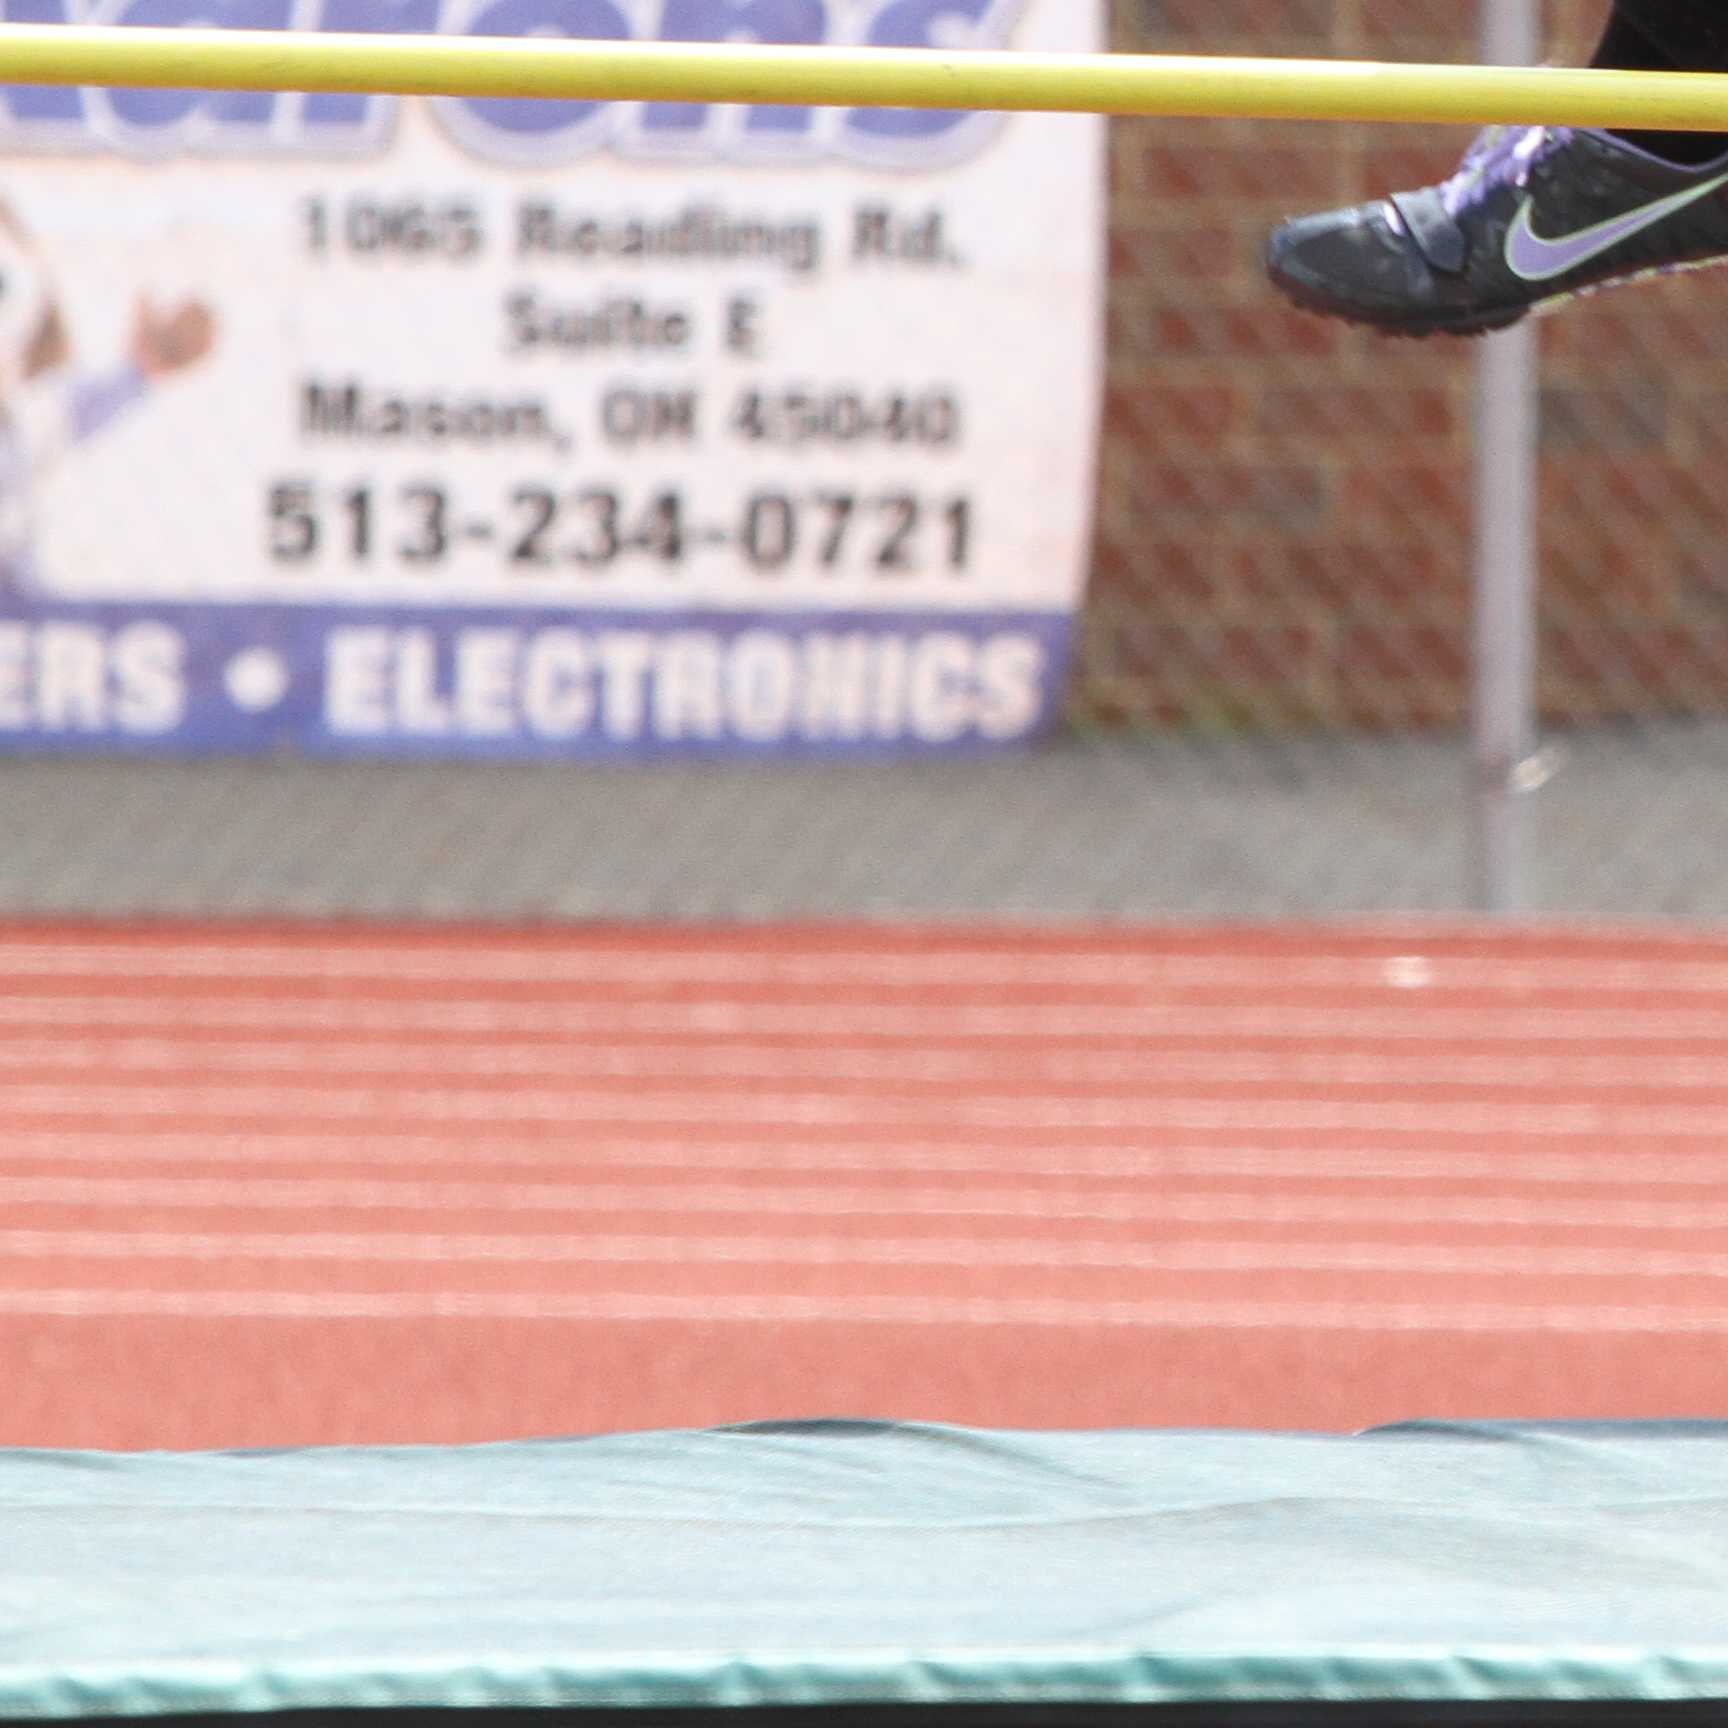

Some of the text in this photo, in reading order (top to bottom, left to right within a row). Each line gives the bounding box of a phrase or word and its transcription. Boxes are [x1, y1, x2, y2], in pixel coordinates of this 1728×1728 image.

[304, 198, 966, 272] 1065 Reading Rd.
[504, 292, 765, 354] Suite E
[300, 382, 962, 450] Mason, OH 45040
[268, 484, 974, 572] 513-234-0721
[324, 624, 1040, 742] ELECTRONICS
